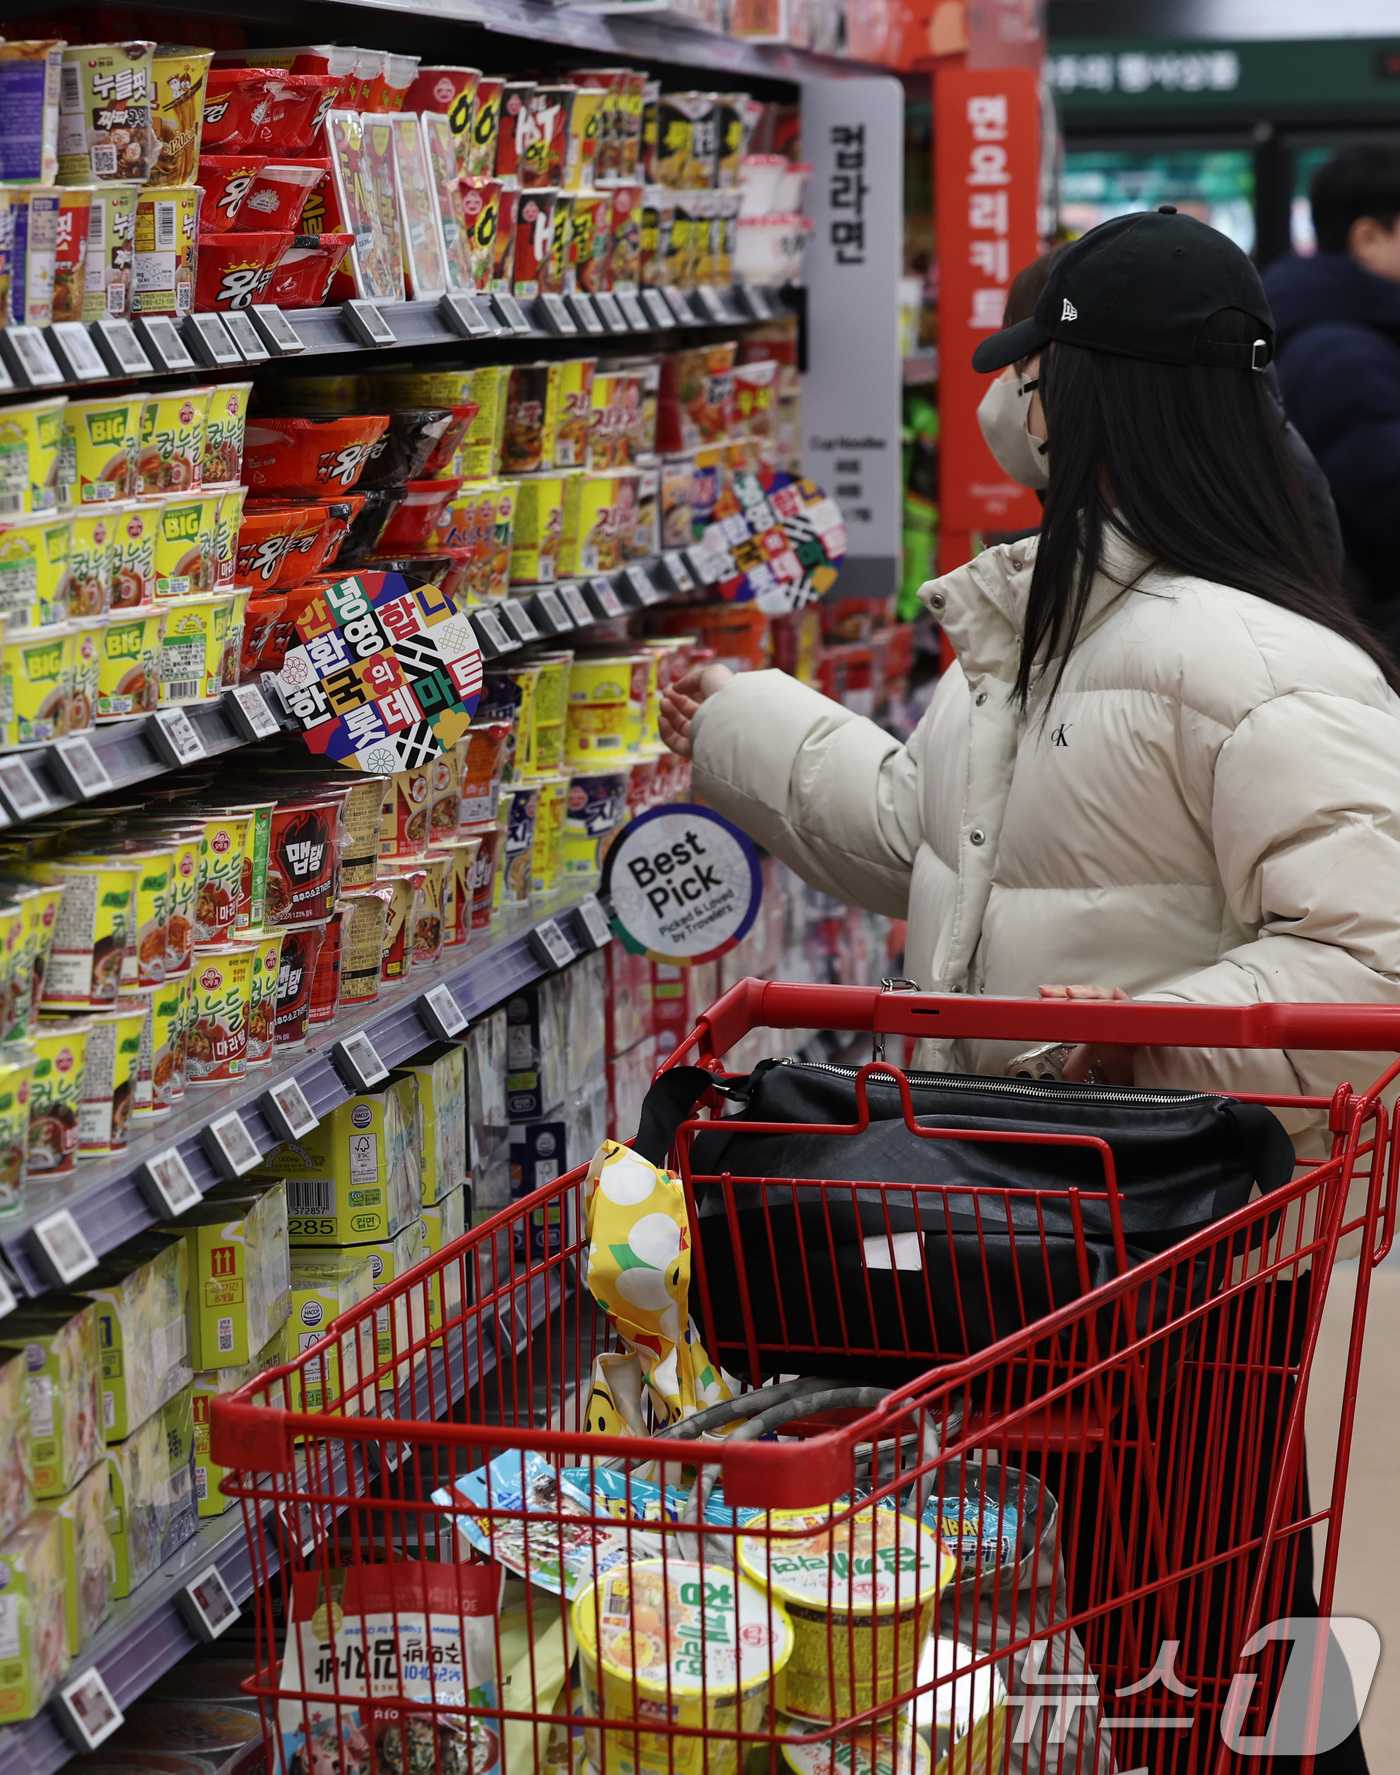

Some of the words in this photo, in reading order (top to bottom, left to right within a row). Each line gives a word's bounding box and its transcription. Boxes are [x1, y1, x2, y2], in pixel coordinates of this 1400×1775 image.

[92, 68, 147, 102] 누들핏
[831, 125, 868, 264] 컵라면
[91, 416, 125, 443] BIG
[163, 516, 199, 539] BIG
[106, 631, 141, 659] BIG
[27, 659, 62, 683] BIG
[285, 840, 324, 876] 맵탱
[628, 830, 706, 889] Best
[647, 864, 723, 919] Pick
[659, 911, 694, 936] Picked
[703, 887, 734, 911] Loved
[672, 932, 686, 943] by
[216, 1028, 246, 1057] 마라탕
[294, 1207, 326, 1215] 572857
[356, 1217, 374, 1229] 컵면
[315, 1638, 398, 1685] 김자반
